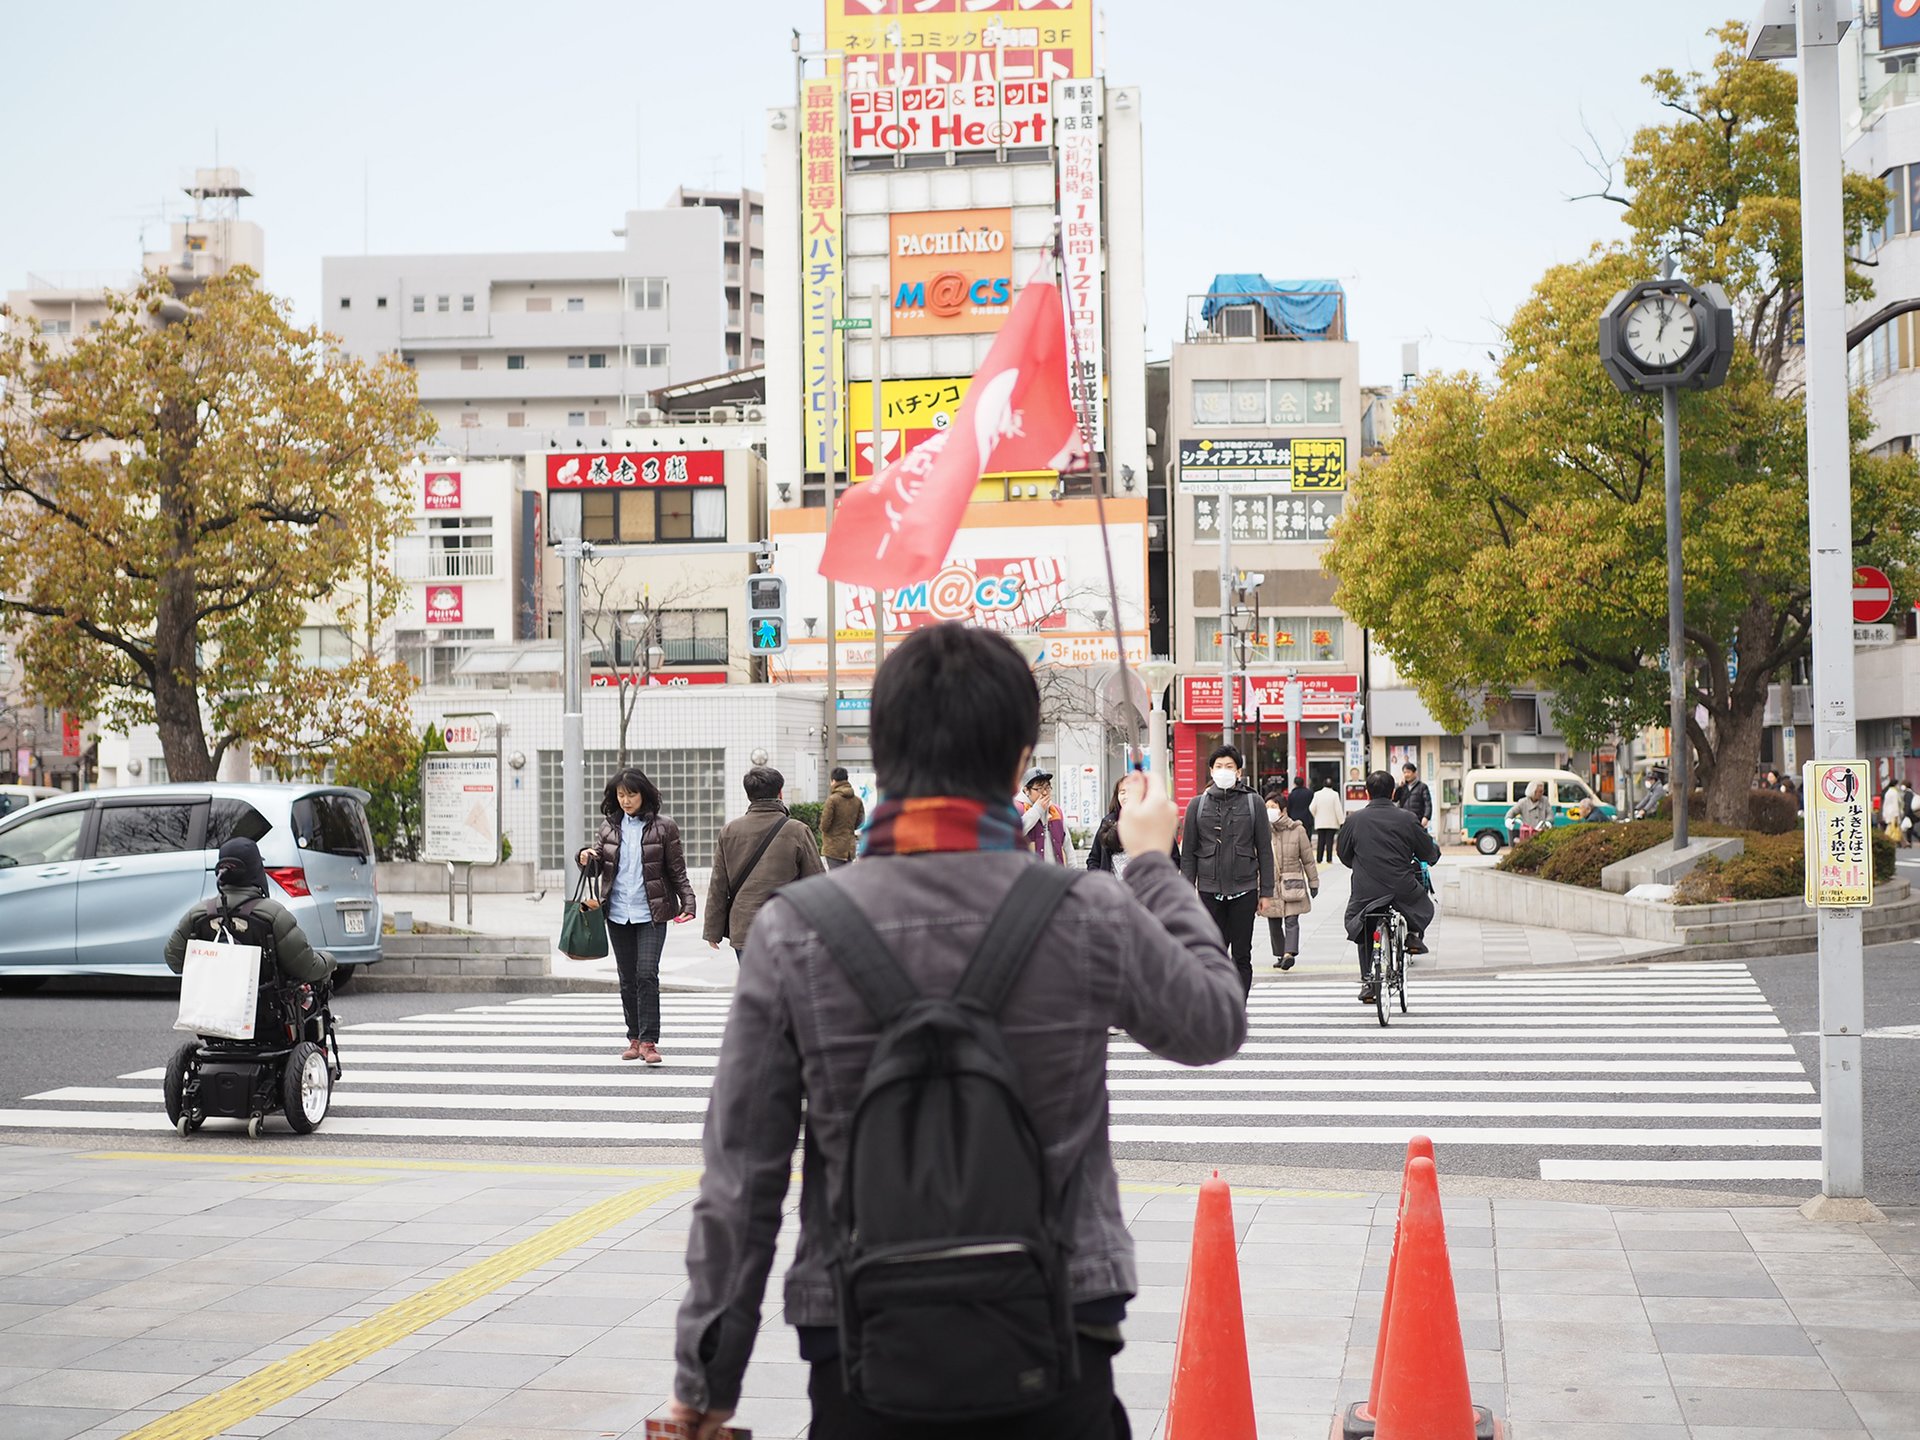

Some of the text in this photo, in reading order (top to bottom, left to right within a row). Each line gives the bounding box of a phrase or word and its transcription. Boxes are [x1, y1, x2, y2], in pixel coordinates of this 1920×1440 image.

[847, 51, 1070, 88] ホットハート
[853, 115, 920, 149] Hot
[897, 230, 1005, 256] PACHINKO
[894, 271, 1010, 318] M@CS
[888, 386, 960, 417] パチンコ
[1182, 449, 1291, 465] シティテラス平井
[1294, 458, 1340, 471] モデル
[1295, 472, 1341, 487] オープン
[427, 496, 459, 504] FUJIYA
[896, 567, 1018, 618] M@CS
[428, 610, 460, 618] FUJIYA
[1051, 642, 1069, 658] 3F
[1101, 648, 1142, 660] Hert
[1830, 816, 1846, 863] ポイ捨て
[1849, 804, 1864, 863] 歩きたばこ
